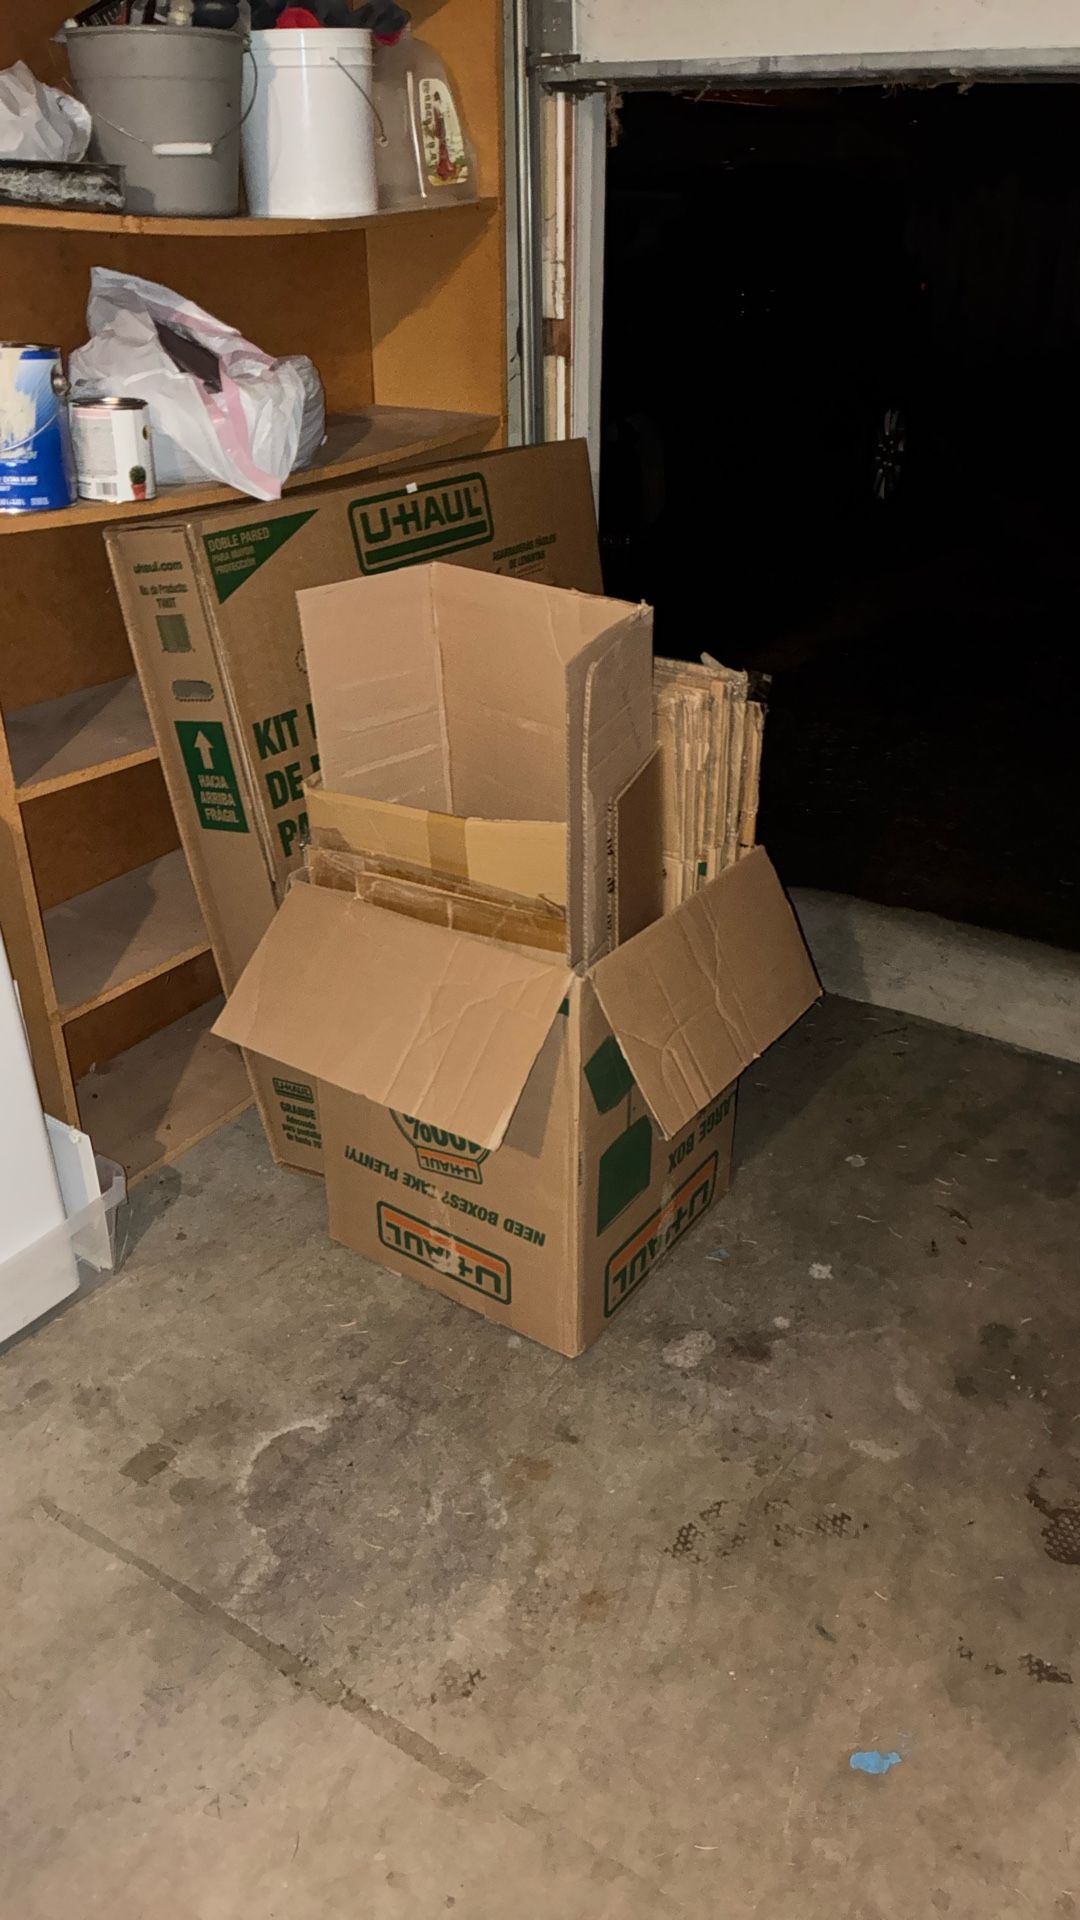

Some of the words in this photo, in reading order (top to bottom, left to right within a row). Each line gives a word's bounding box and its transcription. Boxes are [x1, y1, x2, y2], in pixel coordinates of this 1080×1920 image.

[360, 487, 482, 544] U-HAUL
[207, 533, 240, 552] DOBLE
[240, 527, 270, 545] PARED
[252, 708, 299, 760] KIT
[198, 774, 230, 790] HACIA
[265, 762, 304, 810] DE
[201, 790, 237, 807] ARRIBA
[204, 806, 240, 824] FRÁGIL
[344, 1145, 399, 1181] PLENTY!
[421, 1154, 478, 1180] U-HAUL
[668, 1132, 696, 1173] BOX
[441, 1191, 499, 1226] BOXES?
[503, 1218, 546, 1247] NEED
